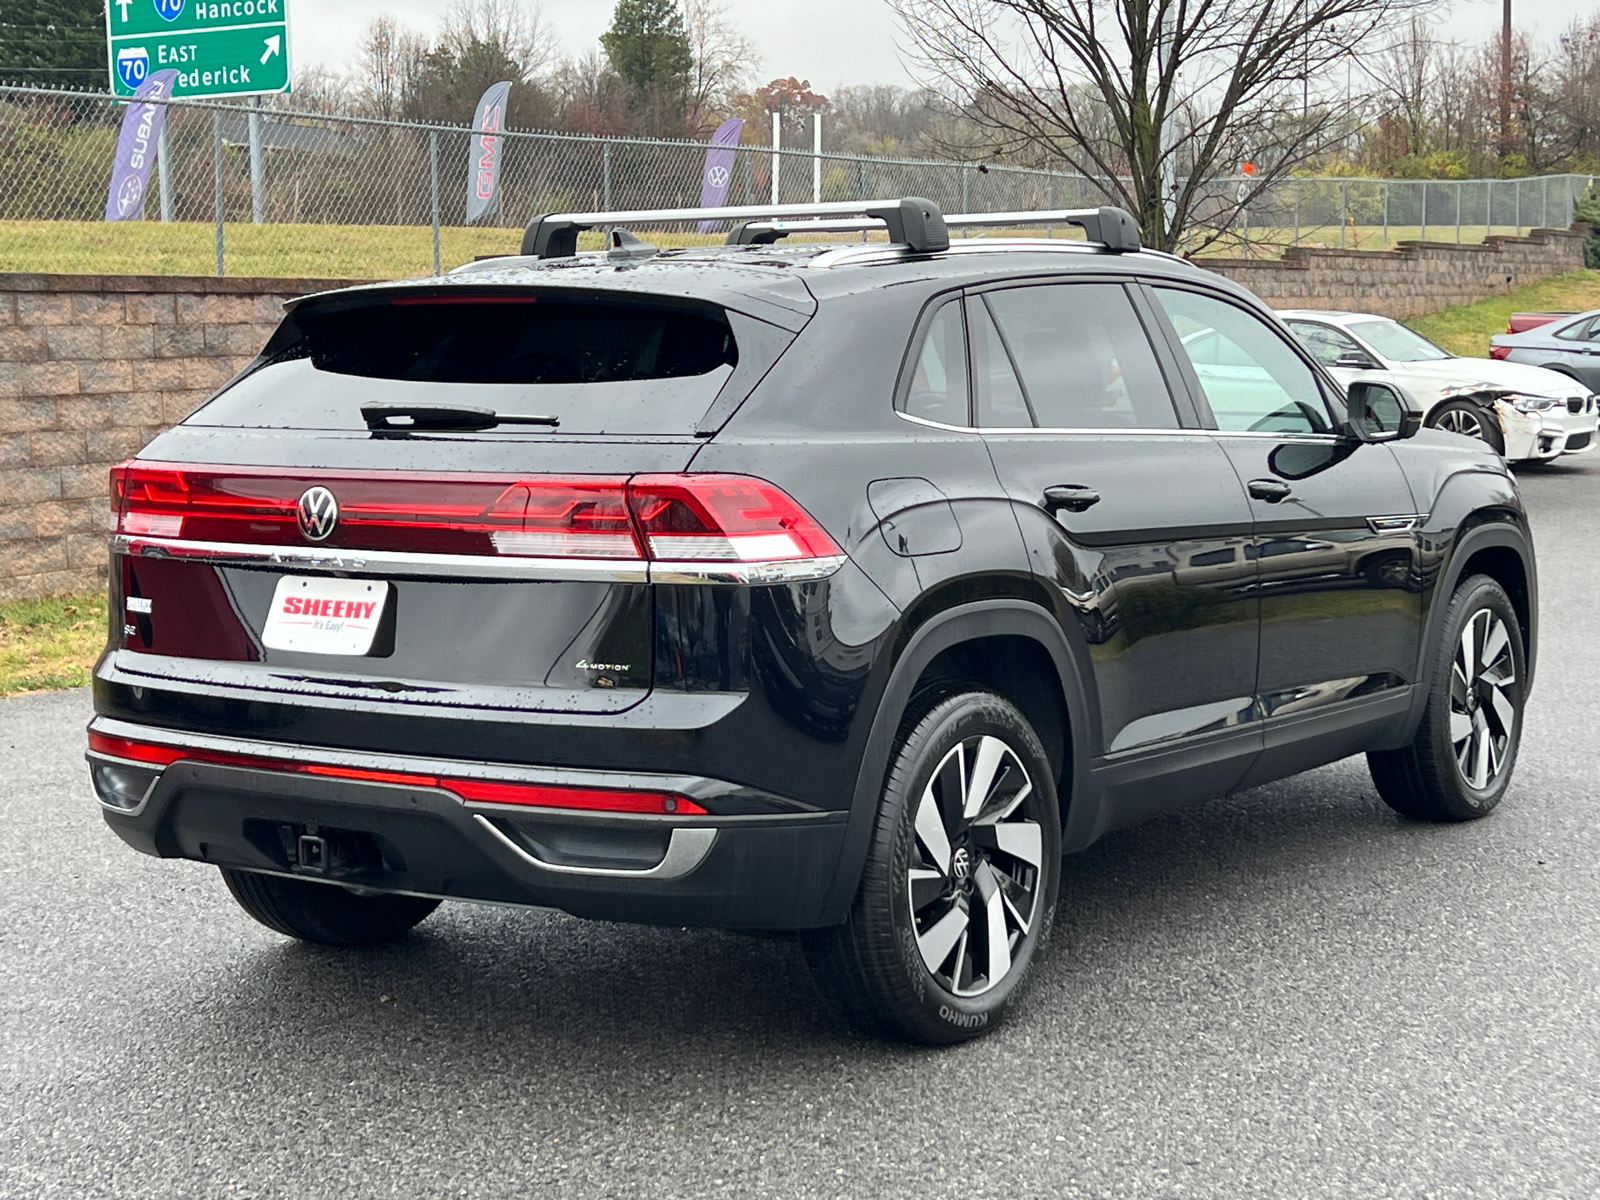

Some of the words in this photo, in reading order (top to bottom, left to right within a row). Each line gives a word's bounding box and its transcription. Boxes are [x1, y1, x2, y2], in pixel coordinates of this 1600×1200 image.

[195, 0, 278, 20] Hancock
[158, 44, 198, 64] EAST
[122, 59, 145, 80] 70
[177, 64, 251, 88] ederick
[477, 104, 500, 199] GMC
[282, 596, 377, 619] SHEEHY
[312, 619, 324, 630] It's
[325, 620, 345, 633] Easy!
[939, 1004, 988, 1028] KUMHO
